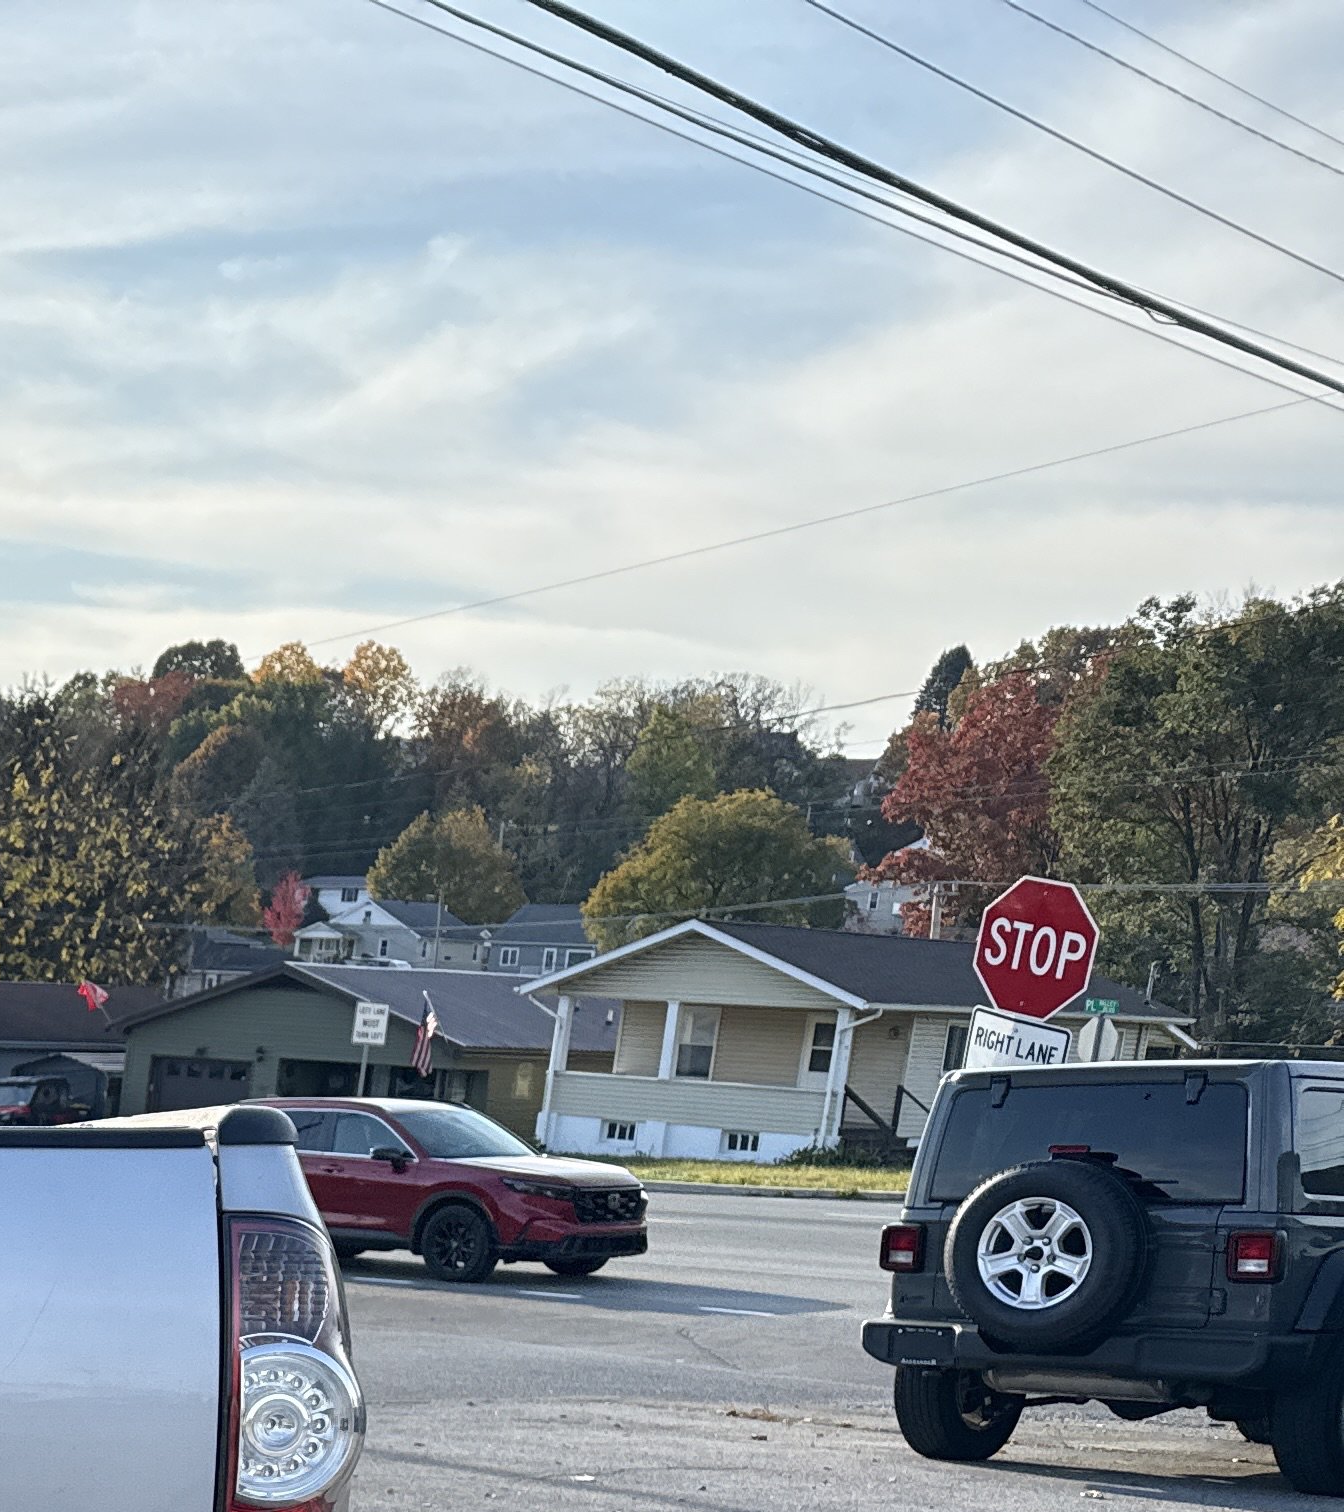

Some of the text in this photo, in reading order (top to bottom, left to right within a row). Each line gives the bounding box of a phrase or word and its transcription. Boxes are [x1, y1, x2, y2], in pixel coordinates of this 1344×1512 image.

[984, 917, 1087, 980] STOP
[974, 1026, 1059, 1065] RIGHT LANE
